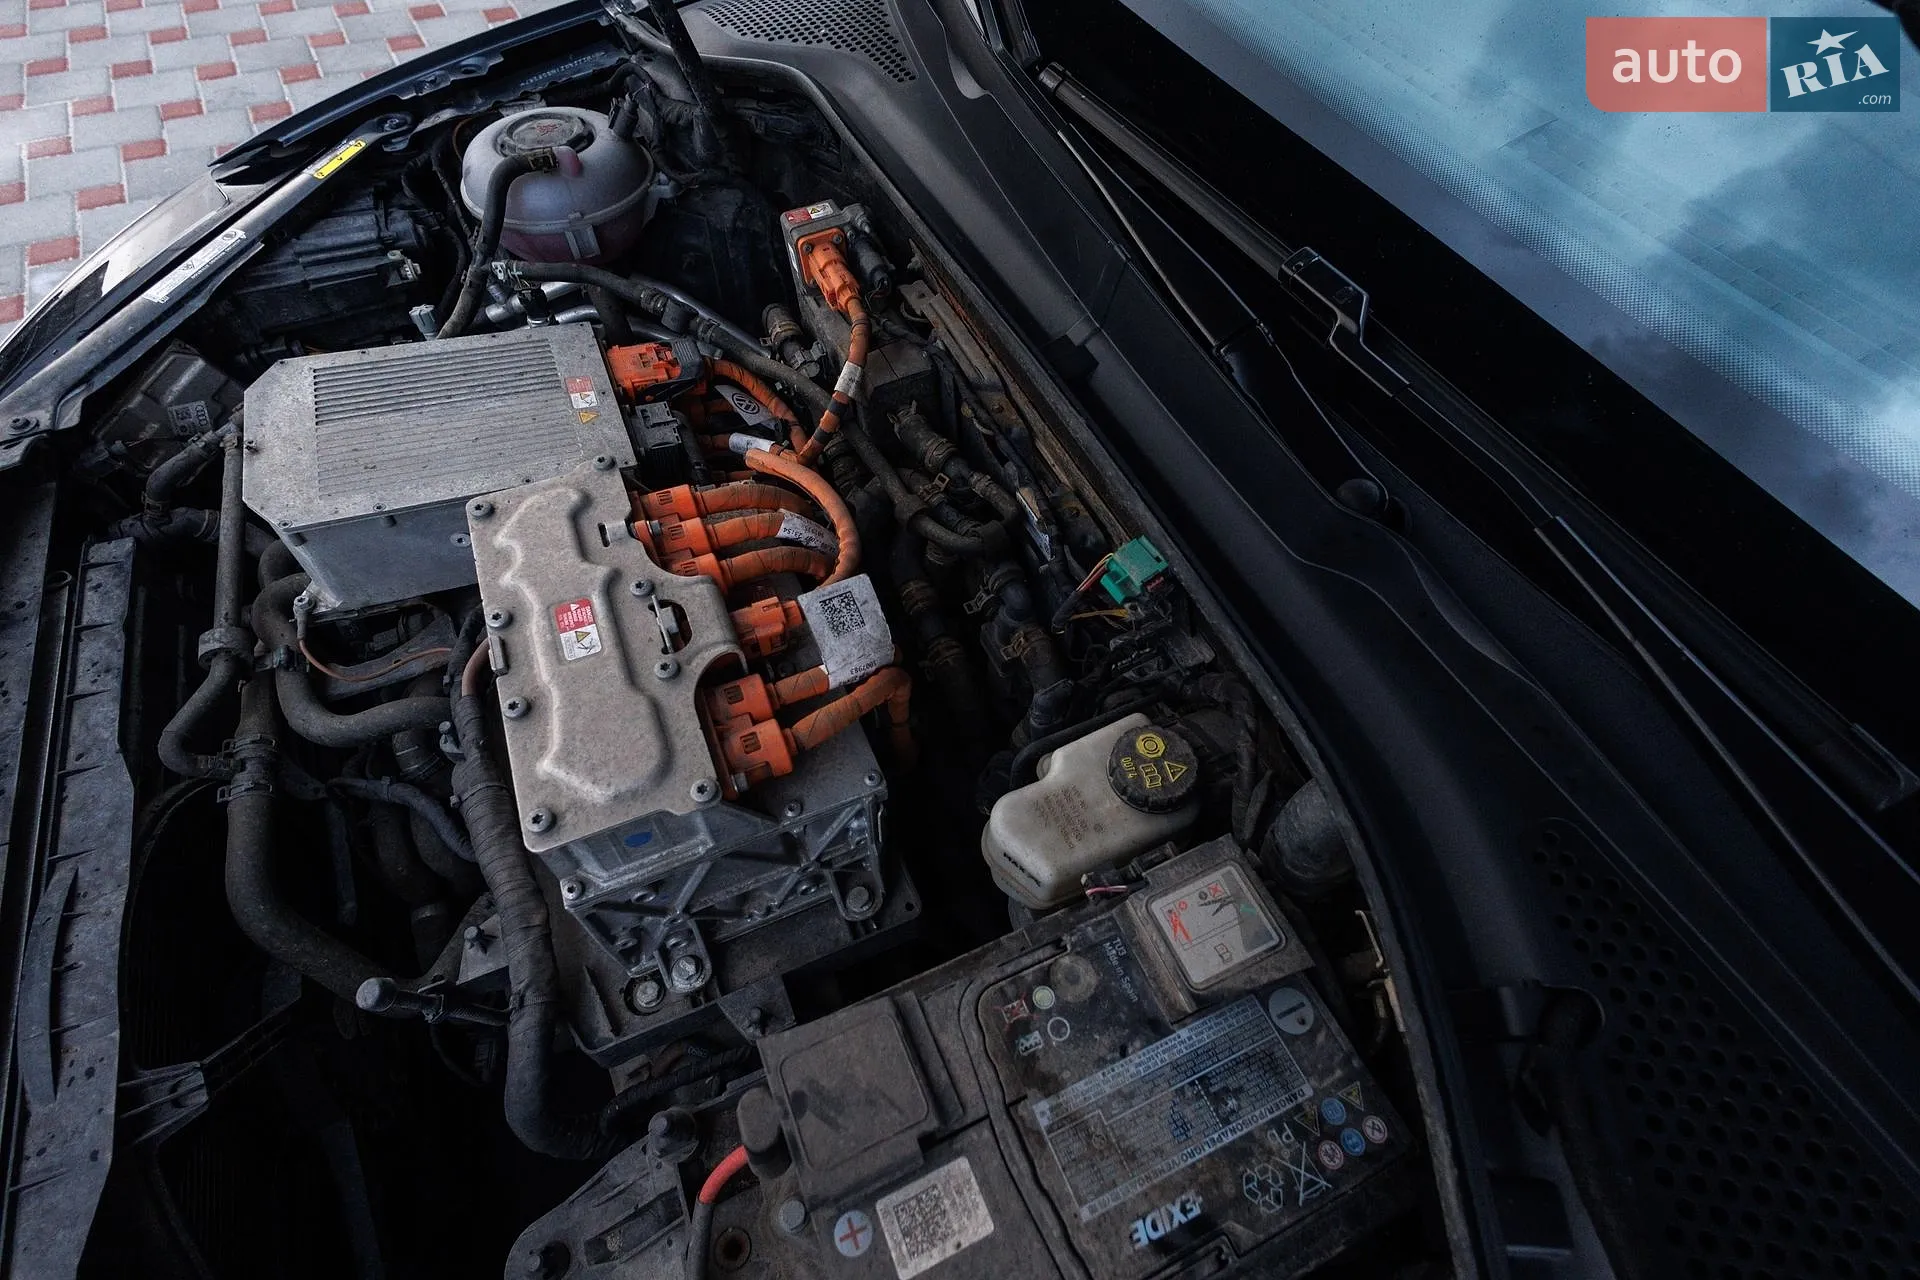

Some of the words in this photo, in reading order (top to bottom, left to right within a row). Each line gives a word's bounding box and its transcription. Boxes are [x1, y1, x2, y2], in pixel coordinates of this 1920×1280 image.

[1120, 755, 1135, 771] DOT
[1102, 940, 1120, 966] Made
[1119, 975, 1139, 1003] Spain
[1264, 1120, 1294, 1149] Pb
[1126, 1190, 1204, 1250] EXIDE
